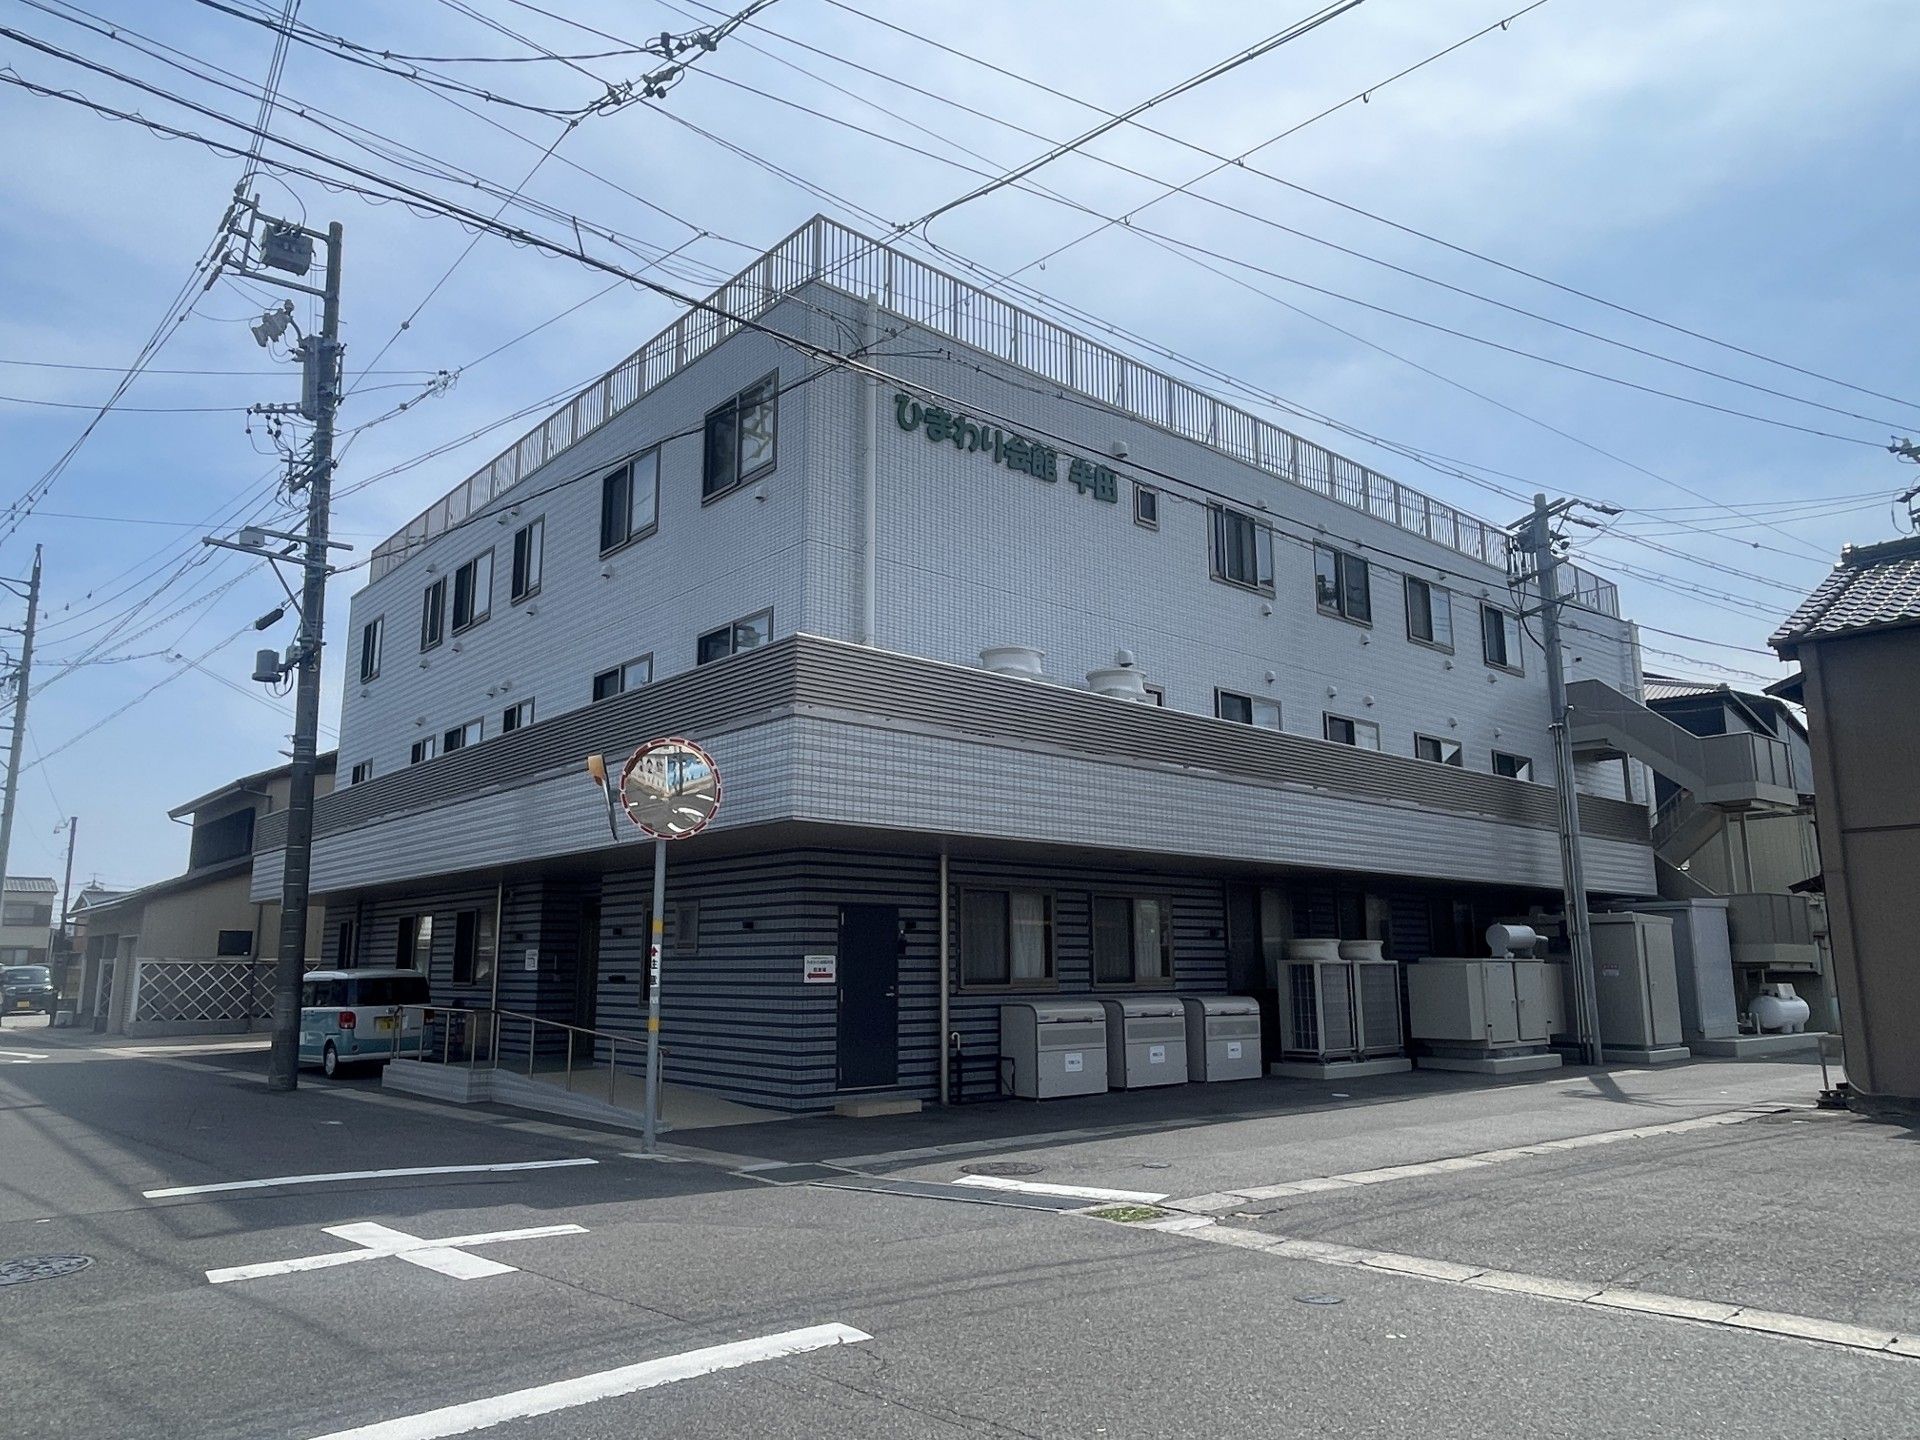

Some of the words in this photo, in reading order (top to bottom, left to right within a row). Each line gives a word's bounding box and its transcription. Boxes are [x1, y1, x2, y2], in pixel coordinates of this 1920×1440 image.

[895, 393, 1058, 483] ひまわり会館
[1068, 457, 1118, 504] 半田
